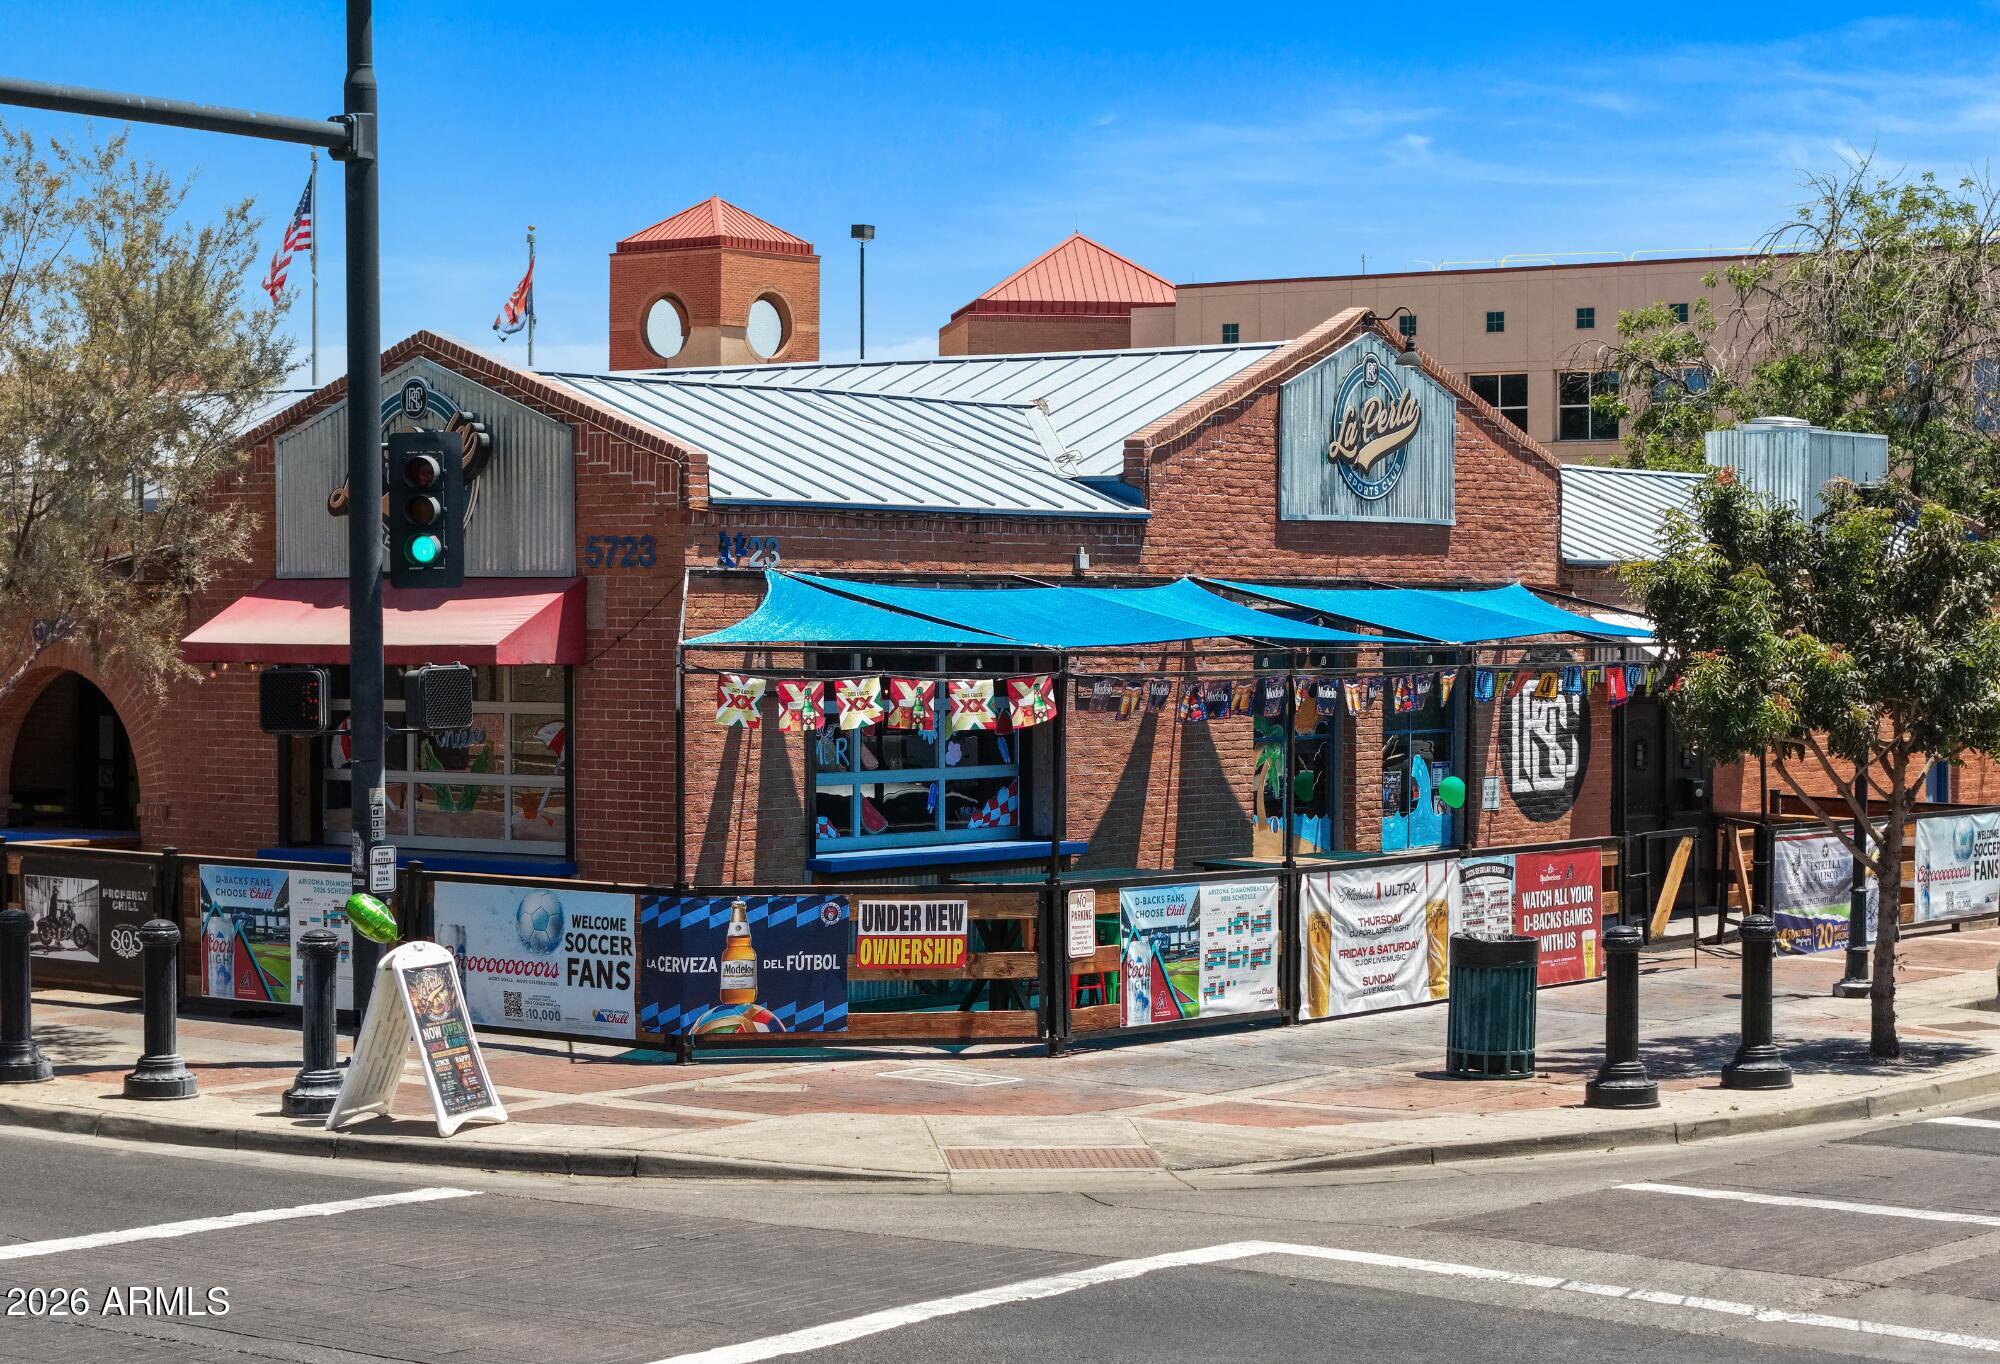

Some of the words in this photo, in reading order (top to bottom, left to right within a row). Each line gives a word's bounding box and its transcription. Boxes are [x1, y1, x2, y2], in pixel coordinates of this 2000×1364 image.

[1328, 405, 1360, 460] La
[1361, 388, 1420, 442] Perla
[1348, 472, 1379, 496] SPORTS
[1381, 463, 1401, 495] CLUB
[583, 535, 657, 568] 5723
[1094, 682, 1113, 695] Modelo
[1265, 686, 1285, 700] Modelo
[1318, 686, 1337, 699] Modelo
[728, 693, 755, 710] XX
[849, 696, 873, 710] XX
[1206, 690, 1227, 703] Modelo
[960, 699, 987, 713] XX
[1977, 828, 1999, 841] WELCOME
[1475, 866, 1491, 875] REGULAR
[1491, 865, 1505, 874] SEASON
[1810, 859, 1841, 871] ESTRELLA
[1974, 859, 1999, 880] FANS
[216, 875, 248, 886] D-BACKS
[250, 877, 273, 887] FANS,
[299, 878, 324, 886] ARIZONA
[102, 888, 148, 901] PROPERLY
[216, 888, 247, 898] CHOOSE
[249, 887, 273, 900] Chill
[1208, 887, 1229, 896] ARIZONA
[1230, 885, 1269, 894] DIAMONDBACKS
[1384, 882, 1417, 897] ULTRA
[1076, 895, 1087, 908] NO
[1135, 895, 1165, 906] D-BACKS
[1232, 893, 1256, 901] SCHEDULE
[1522, 890, 1552, 909] WATCH
[1554, 887, 1569, 903] ALL
[1570, 885, 1594, 902] YOUR
[112, 901, 139, 912] CHILL
[1135, 908, 1164, 919] CHOOSE
[1166, 904, 1187, 917] Chill
[861, 904, 921, 932] UNDER
[925, 904, 964, 932] NEW
[1071, 909, 1092, 921] PARKING
[1358, 913, 1402, 927] THURSDAY
[1523, 910, 1561, 932] D-BACKS
[1563, 907, 1593, 927] GAMES
[572, 914, 627, 932] WELCOME
[1358, 929, 1371, 937] FOR
[1372, 926, 1391, 935] LADIES
[1392, 924, 1410, 933] NIGHT
[1815, 922, 1834, 949] $20
[110, 929, 143, 952] 805
[564, 932, 633, 956] SOCCER
[1540, 932, 1564, 952] WITH
[1565, 931, 1576, 949] US
[860, 938, 964, 965] OWNERSHIP
[1339, 944, 1368, 960] FRIDAY
[1368, 945, 1375, 956] &
[1376, 939, 1421, 955] SATURDAY
[646, 958, 656, 969] LA
[657, 956, 718, 973] CERVEZA
[763, 959, 784, 969] DEL
[786, 951, 840, 972] FÚTBOL
[1355, 959, 1363, 967] DJ
[1372, 956, 1384, 964] LIVE
[1383, 953, 1406, 963] MUSIC
[567, 957, 631, 991] FANS
[725, 964, 753, 975] Modelo
[1362, 972, 1397, 987] SUNDAY
[1363, 986, 1376, 995] LIVE
[1376, 984, 1396, 993] MUSIC
[526, 1008, 561, 1022] $10,000
[606, 1013, 630, 1024] Chill
[422, 1025, 442, 1041] NOW
[441, 1021, 465, 1037] OPEN
